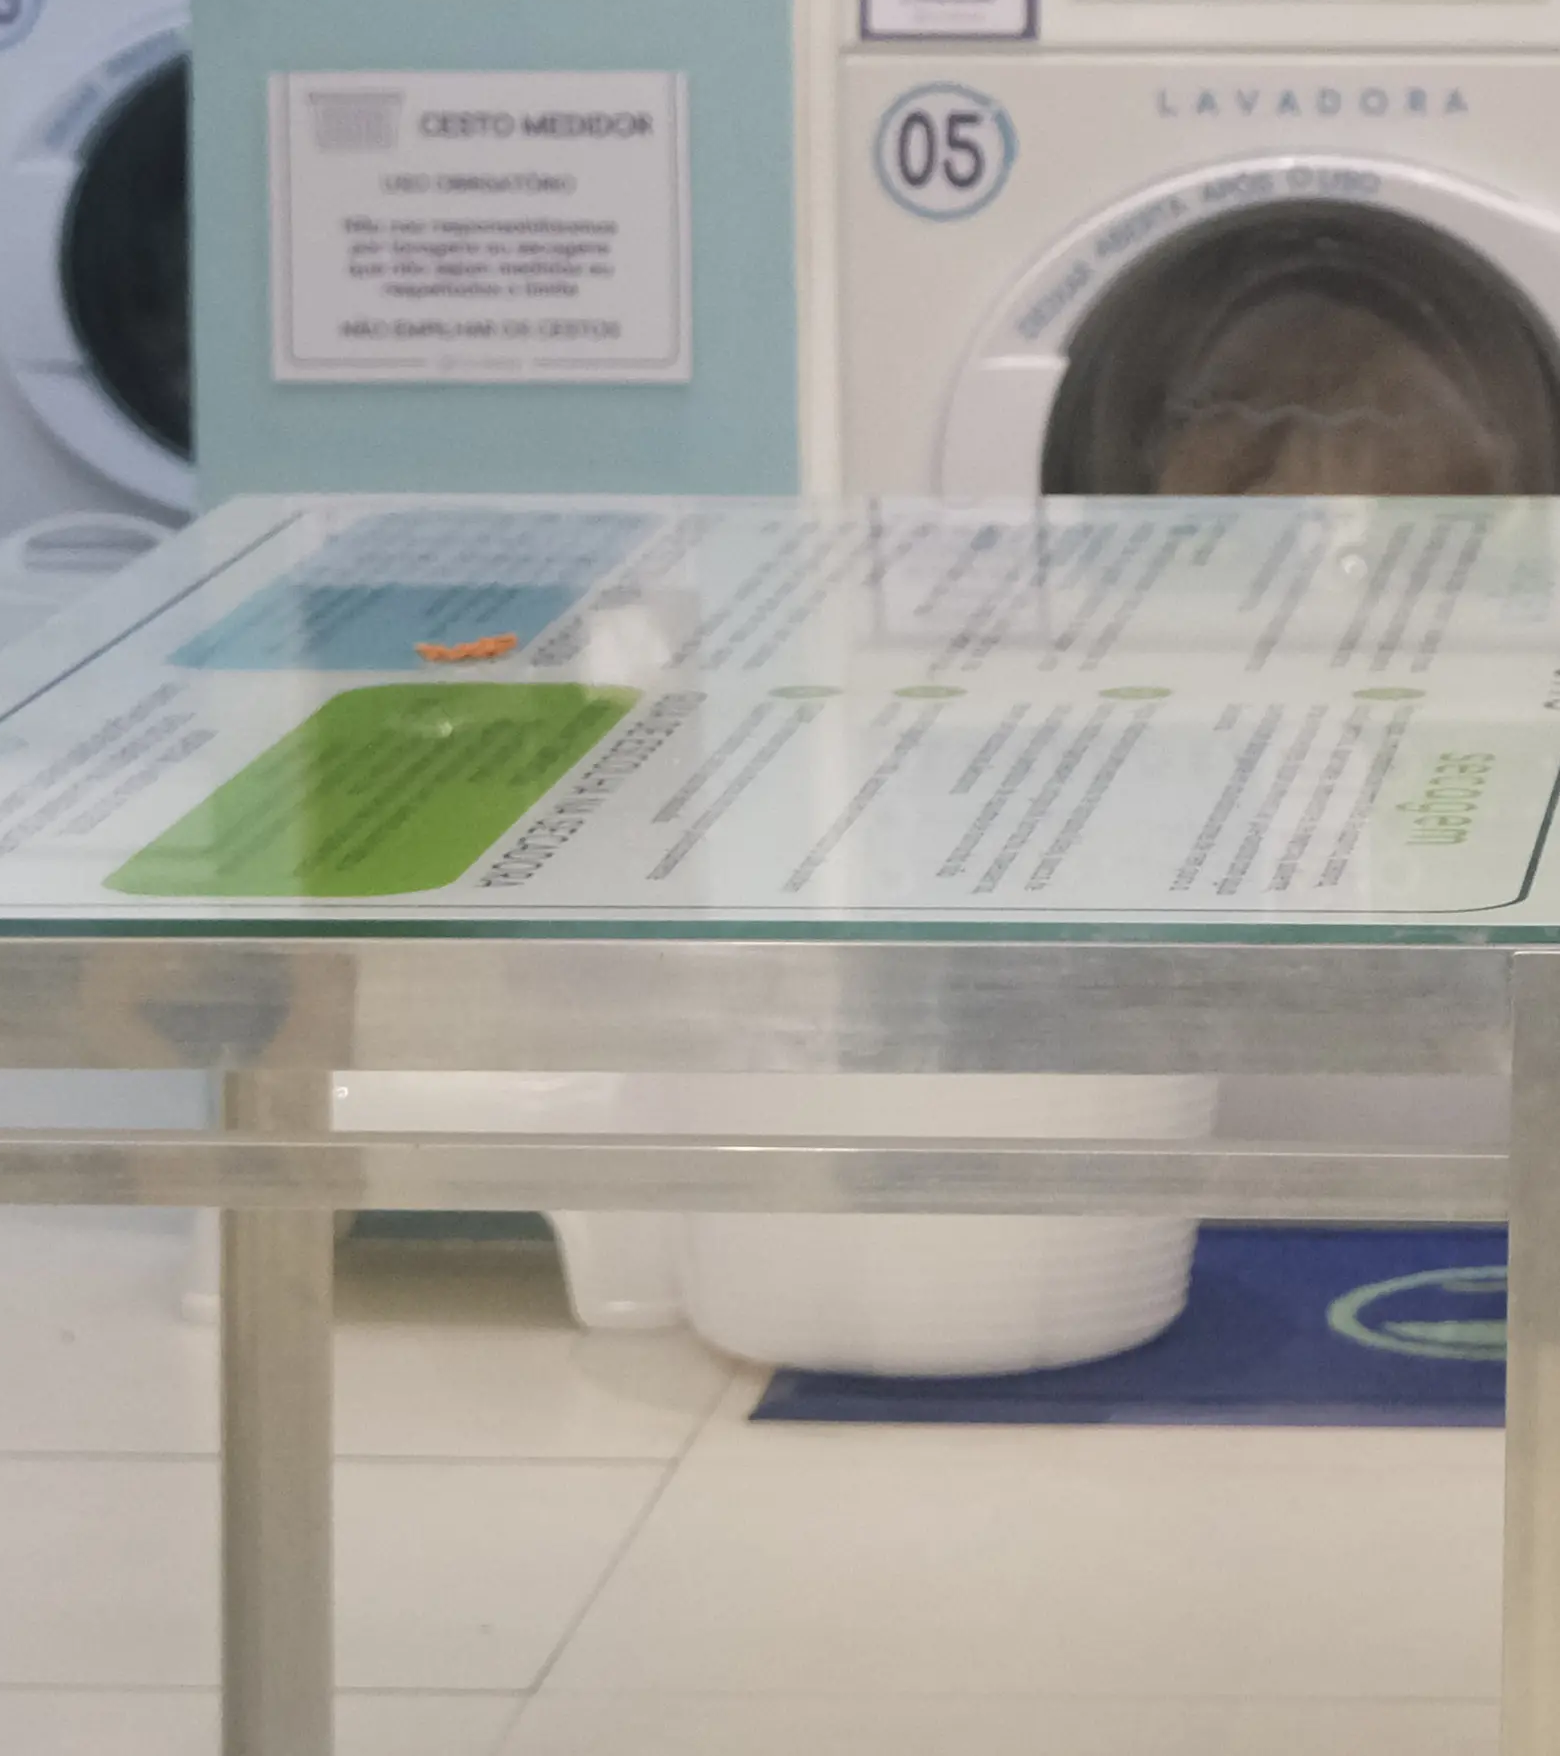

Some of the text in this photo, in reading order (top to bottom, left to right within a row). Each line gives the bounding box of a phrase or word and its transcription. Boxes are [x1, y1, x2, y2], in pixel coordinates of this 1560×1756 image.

[1156, 87, 1469, 117] LAVADORA
[897, 109, 985, 188] 05
[1394, 752, 1496, 846] secagem
